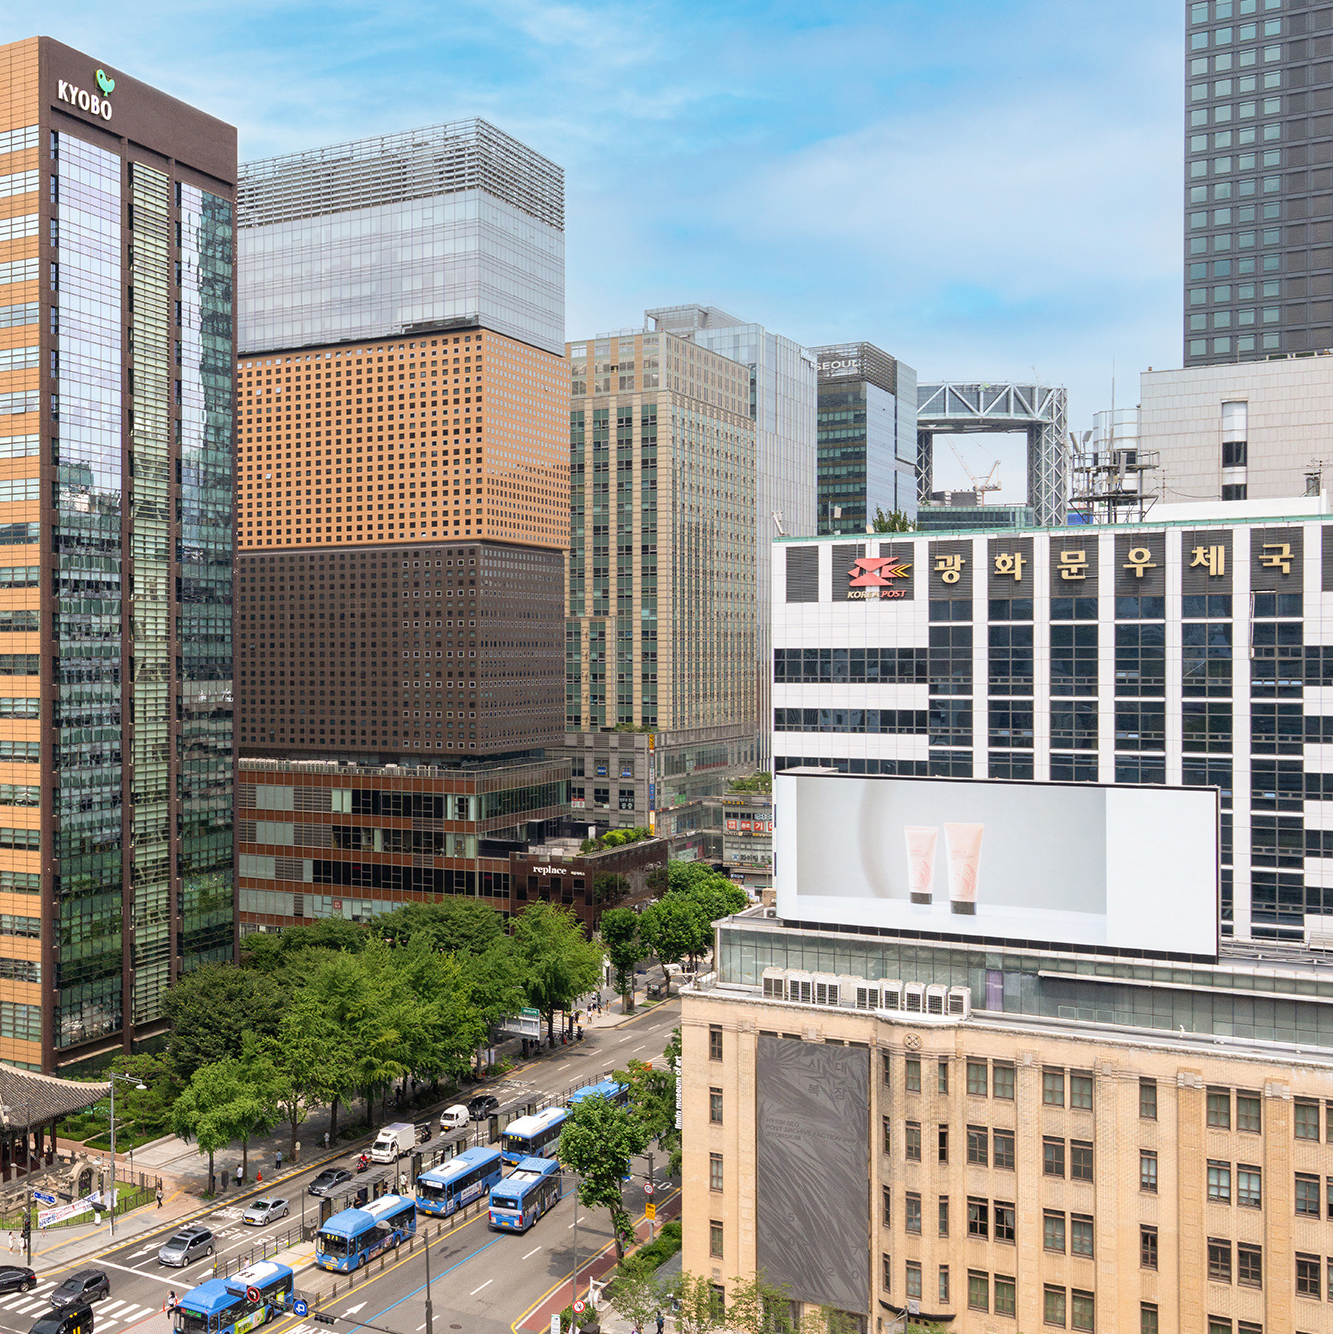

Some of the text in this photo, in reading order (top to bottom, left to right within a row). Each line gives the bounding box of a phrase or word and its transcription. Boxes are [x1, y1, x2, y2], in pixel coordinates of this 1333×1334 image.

[58, 79, 113, 121] KYOBO
[933, 543, 1295, 584] 광화문우체국
[847, 589, 907, 599] KOREA POST
[532, 865, 567, 876] replace
[674, 1066, 682, 1077] of
[326, 1233, 339, 1242] 271
